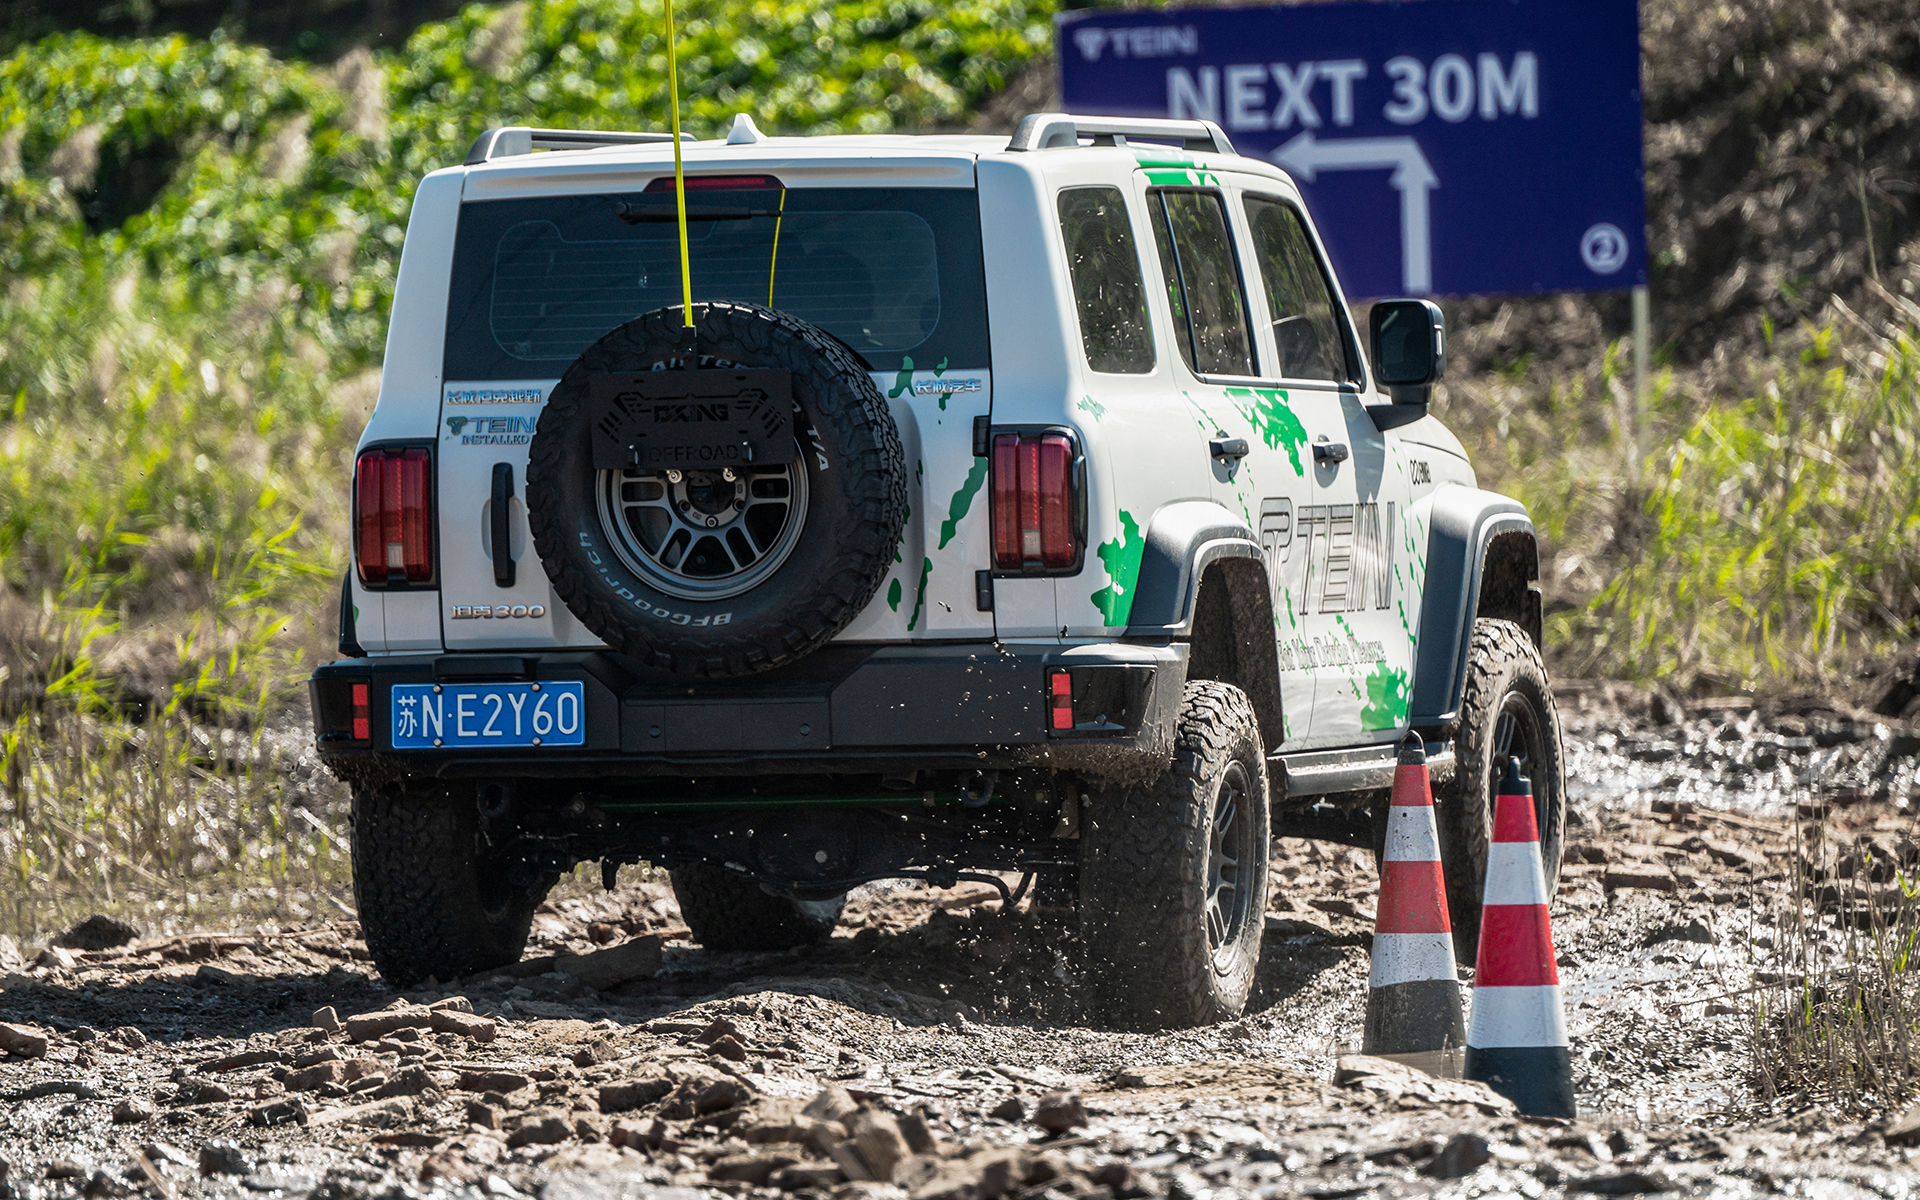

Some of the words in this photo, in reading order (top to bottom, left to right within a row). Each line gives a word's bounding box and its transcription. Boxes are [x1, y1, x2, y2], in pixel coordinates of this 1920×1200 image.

[1113, 25, 1197, 56] TEIN
[1166, 58, 1366, 132] NEXT
[1383, 51, 1540, 123] 30M
[916, 378, 982, 395] 长城汽车
[446, 389, 541, 405] 长城坦克越野
[466, 416, 536, 433] TEIN
[461, 434, 530, 445] INSTALLED
[653, 444, 740, 462] OFFROAD
[1297, 501, 1395, 616] TEIN
[579, 532, 733, 627] BFGoodrich
